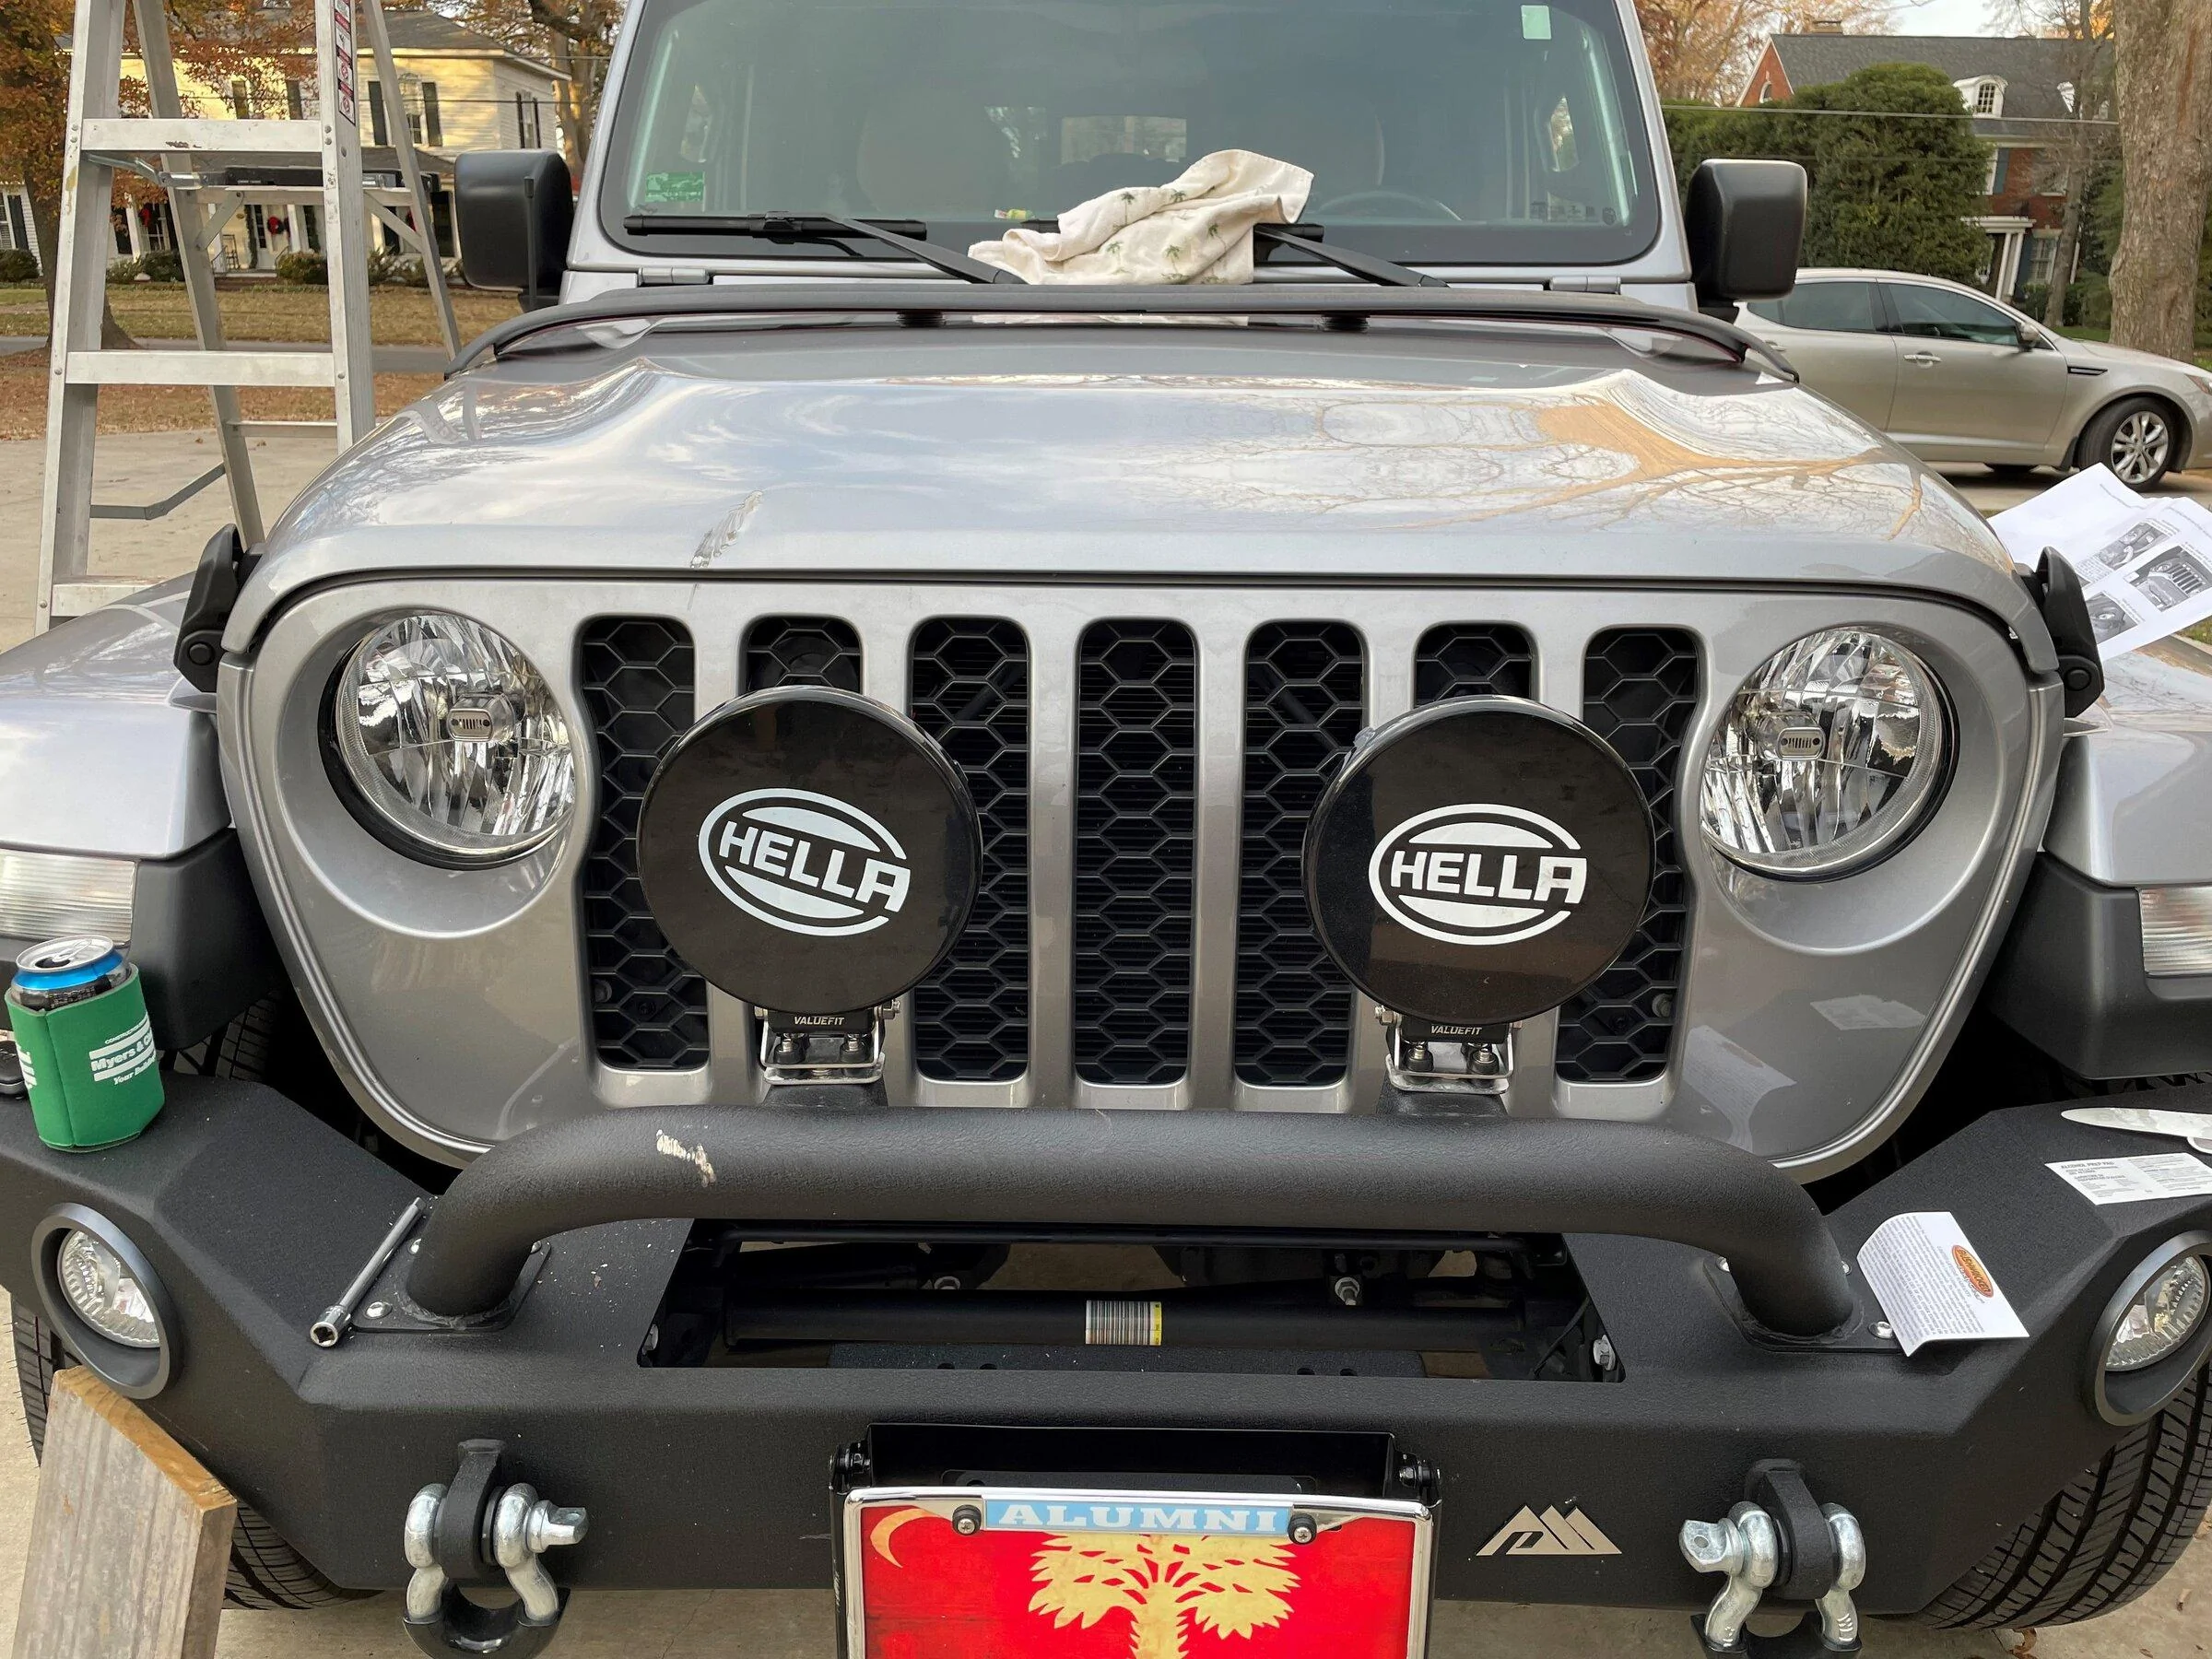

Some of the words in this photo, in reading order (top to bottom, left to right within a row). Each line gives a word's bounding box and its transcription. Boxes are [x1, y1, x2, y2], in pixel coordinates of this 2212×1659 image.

[719, 821, 911, 912] HELLA
[1391, 851, 1587, 904] HELLA
[794, 1016, 845, 1026] VALUEFIT
[1430, 1025, 1482, 1035] VALUEFIT
[91, 1049, 135, 1071] Myers
[136, 1041, 145, 1053] &
[113, 1072, 135, 1085] Your
[999, 1504, 1277, 1532] ALUMNI
